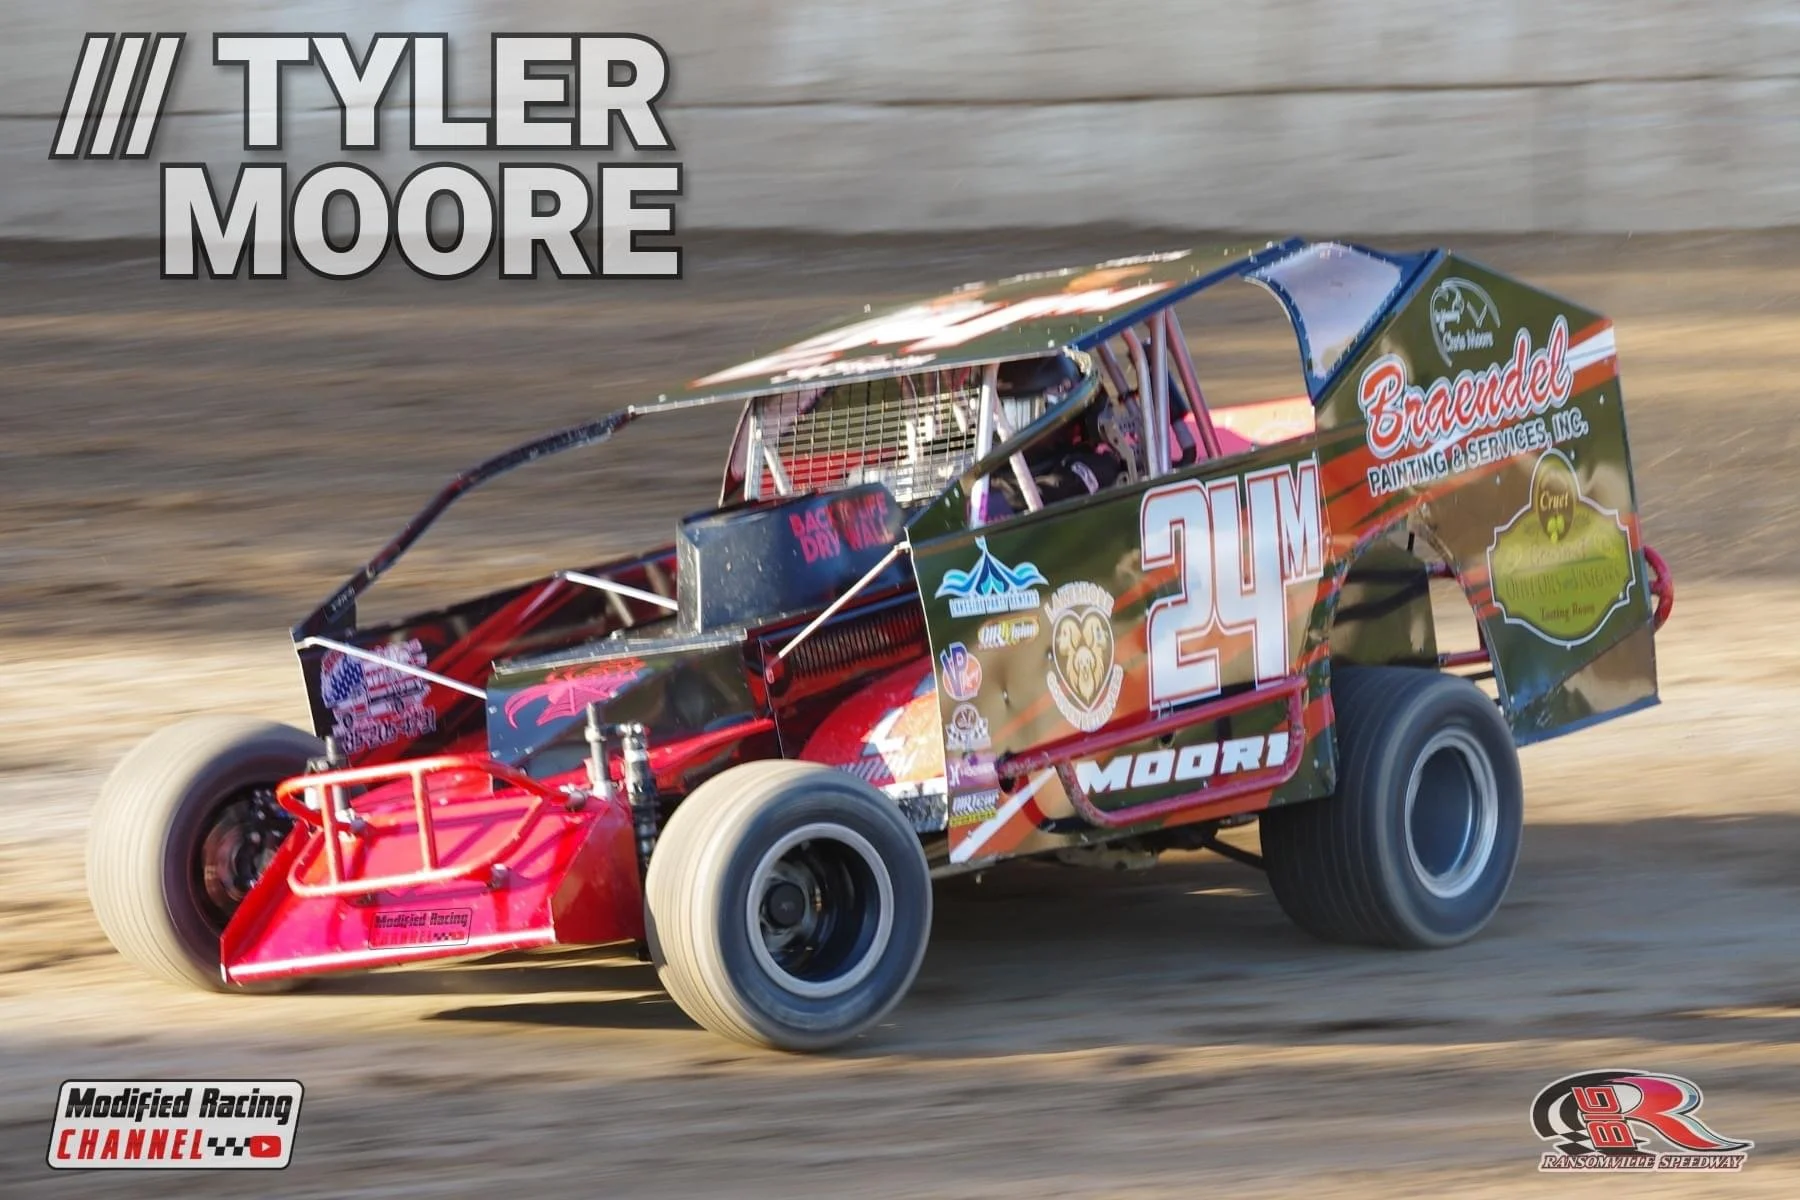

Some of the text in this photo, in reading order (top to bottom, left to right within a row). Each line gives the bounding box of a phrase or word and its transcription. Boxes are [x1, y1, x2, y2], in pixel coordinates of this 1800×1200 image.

[1358, 314, 1574, 459] Braendel
[1367, 446, 1448, 496] PAINTING
[1451, 446, 1466, 474] &
[1551, 406, 1589, 442] INC.
[1539, 491, 1569, 511] Cruet
[374, 911, 468, 929] Modified Racing
